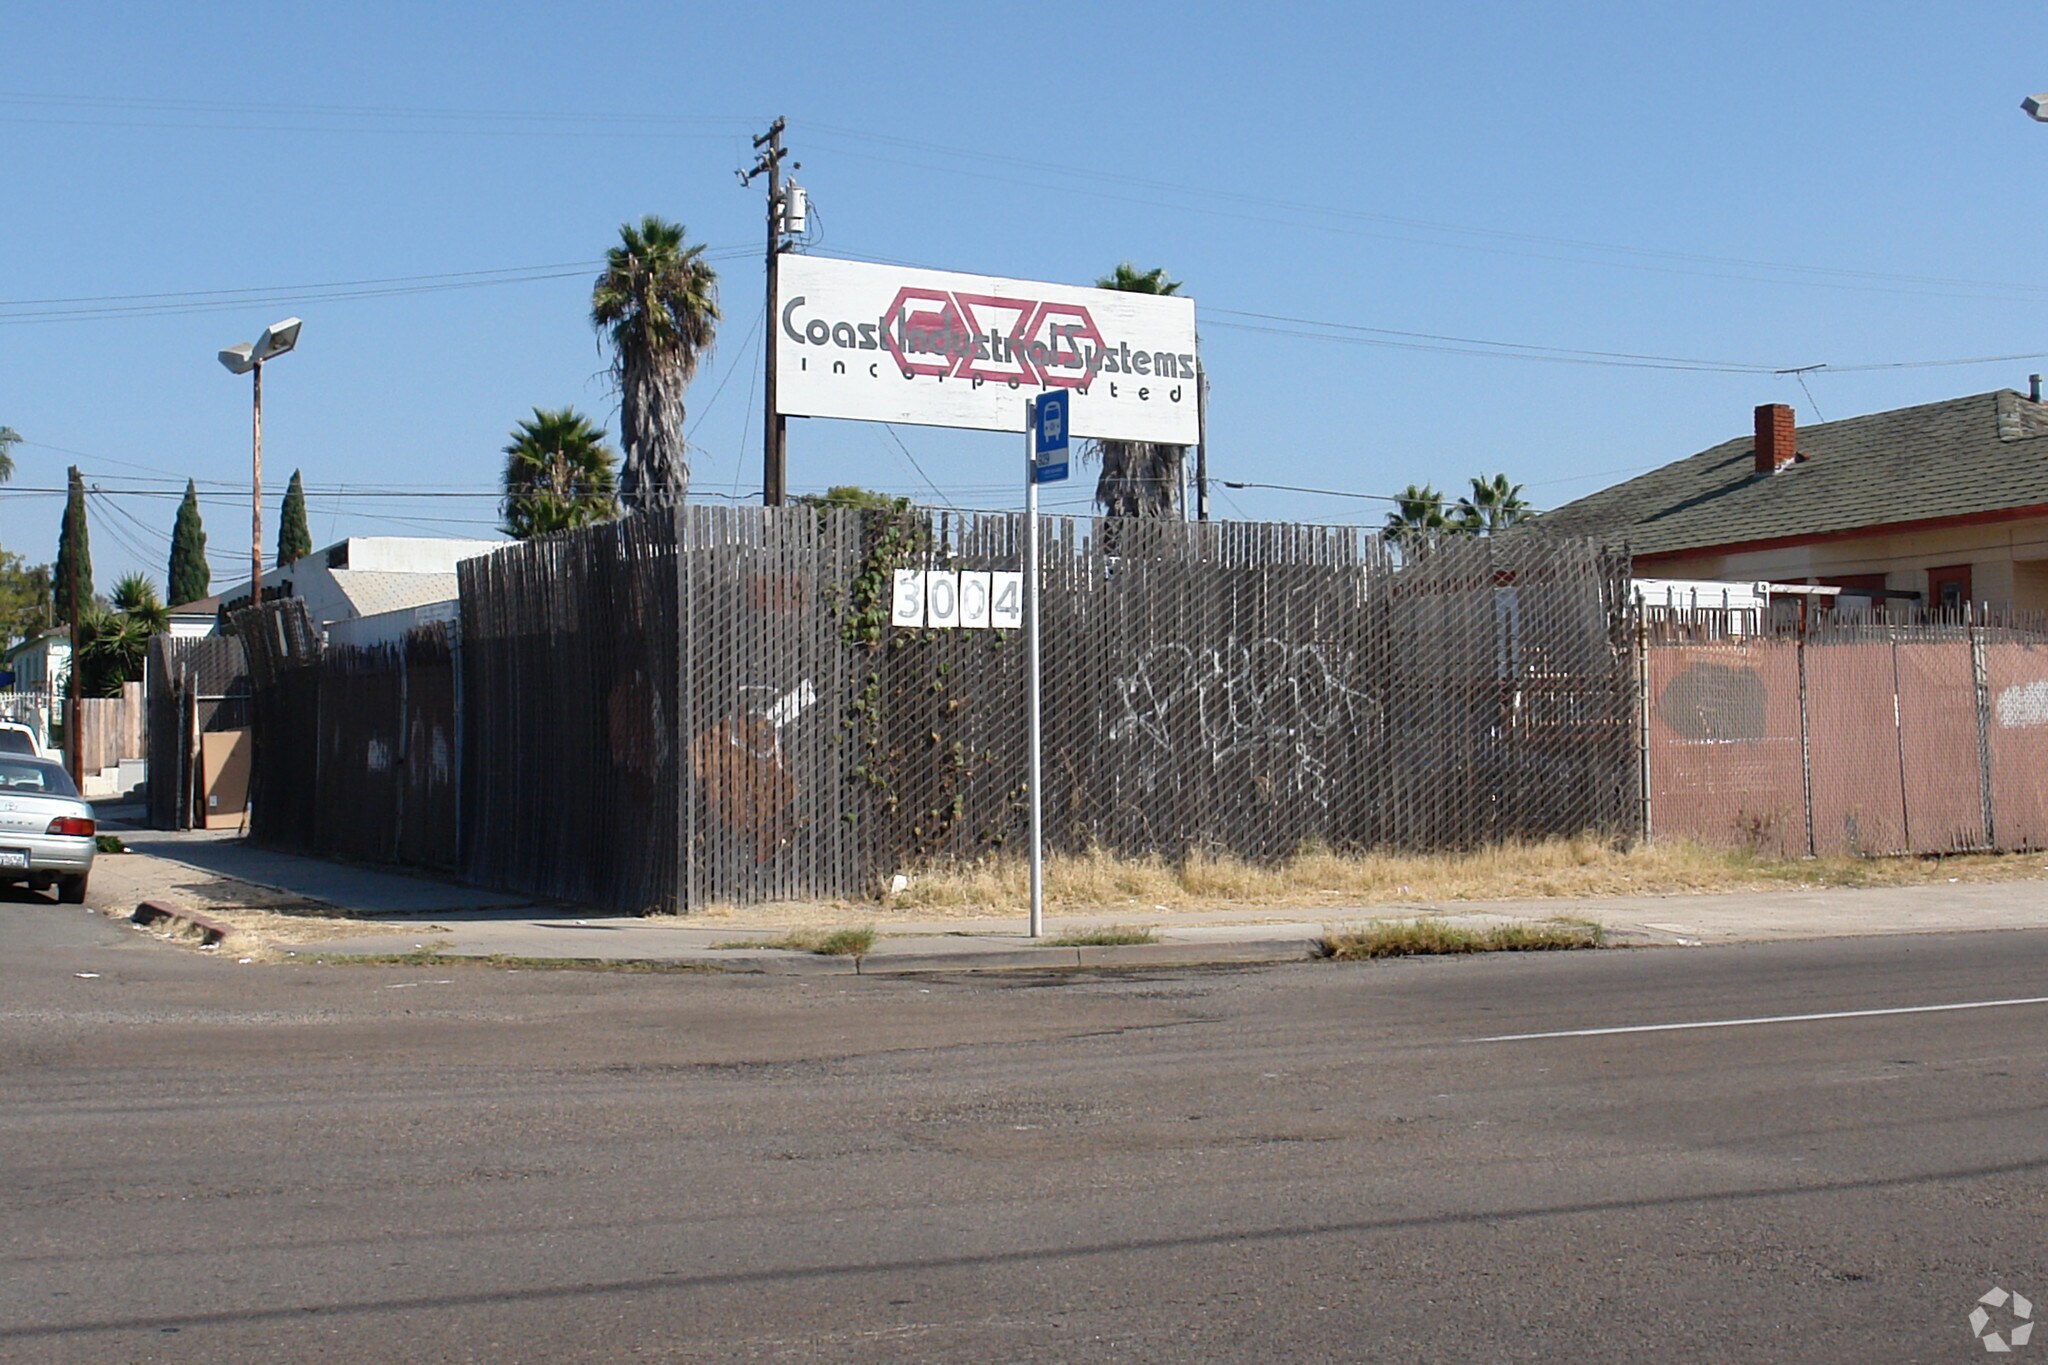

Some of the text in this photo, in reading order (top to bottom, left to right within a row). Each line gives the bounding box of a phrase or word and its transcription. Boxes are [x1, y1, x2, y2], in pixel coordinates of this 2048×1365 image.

[782, 296, 1195, 379] Coast Industrial Systems
[898, 577, 1019, 620] 3004
